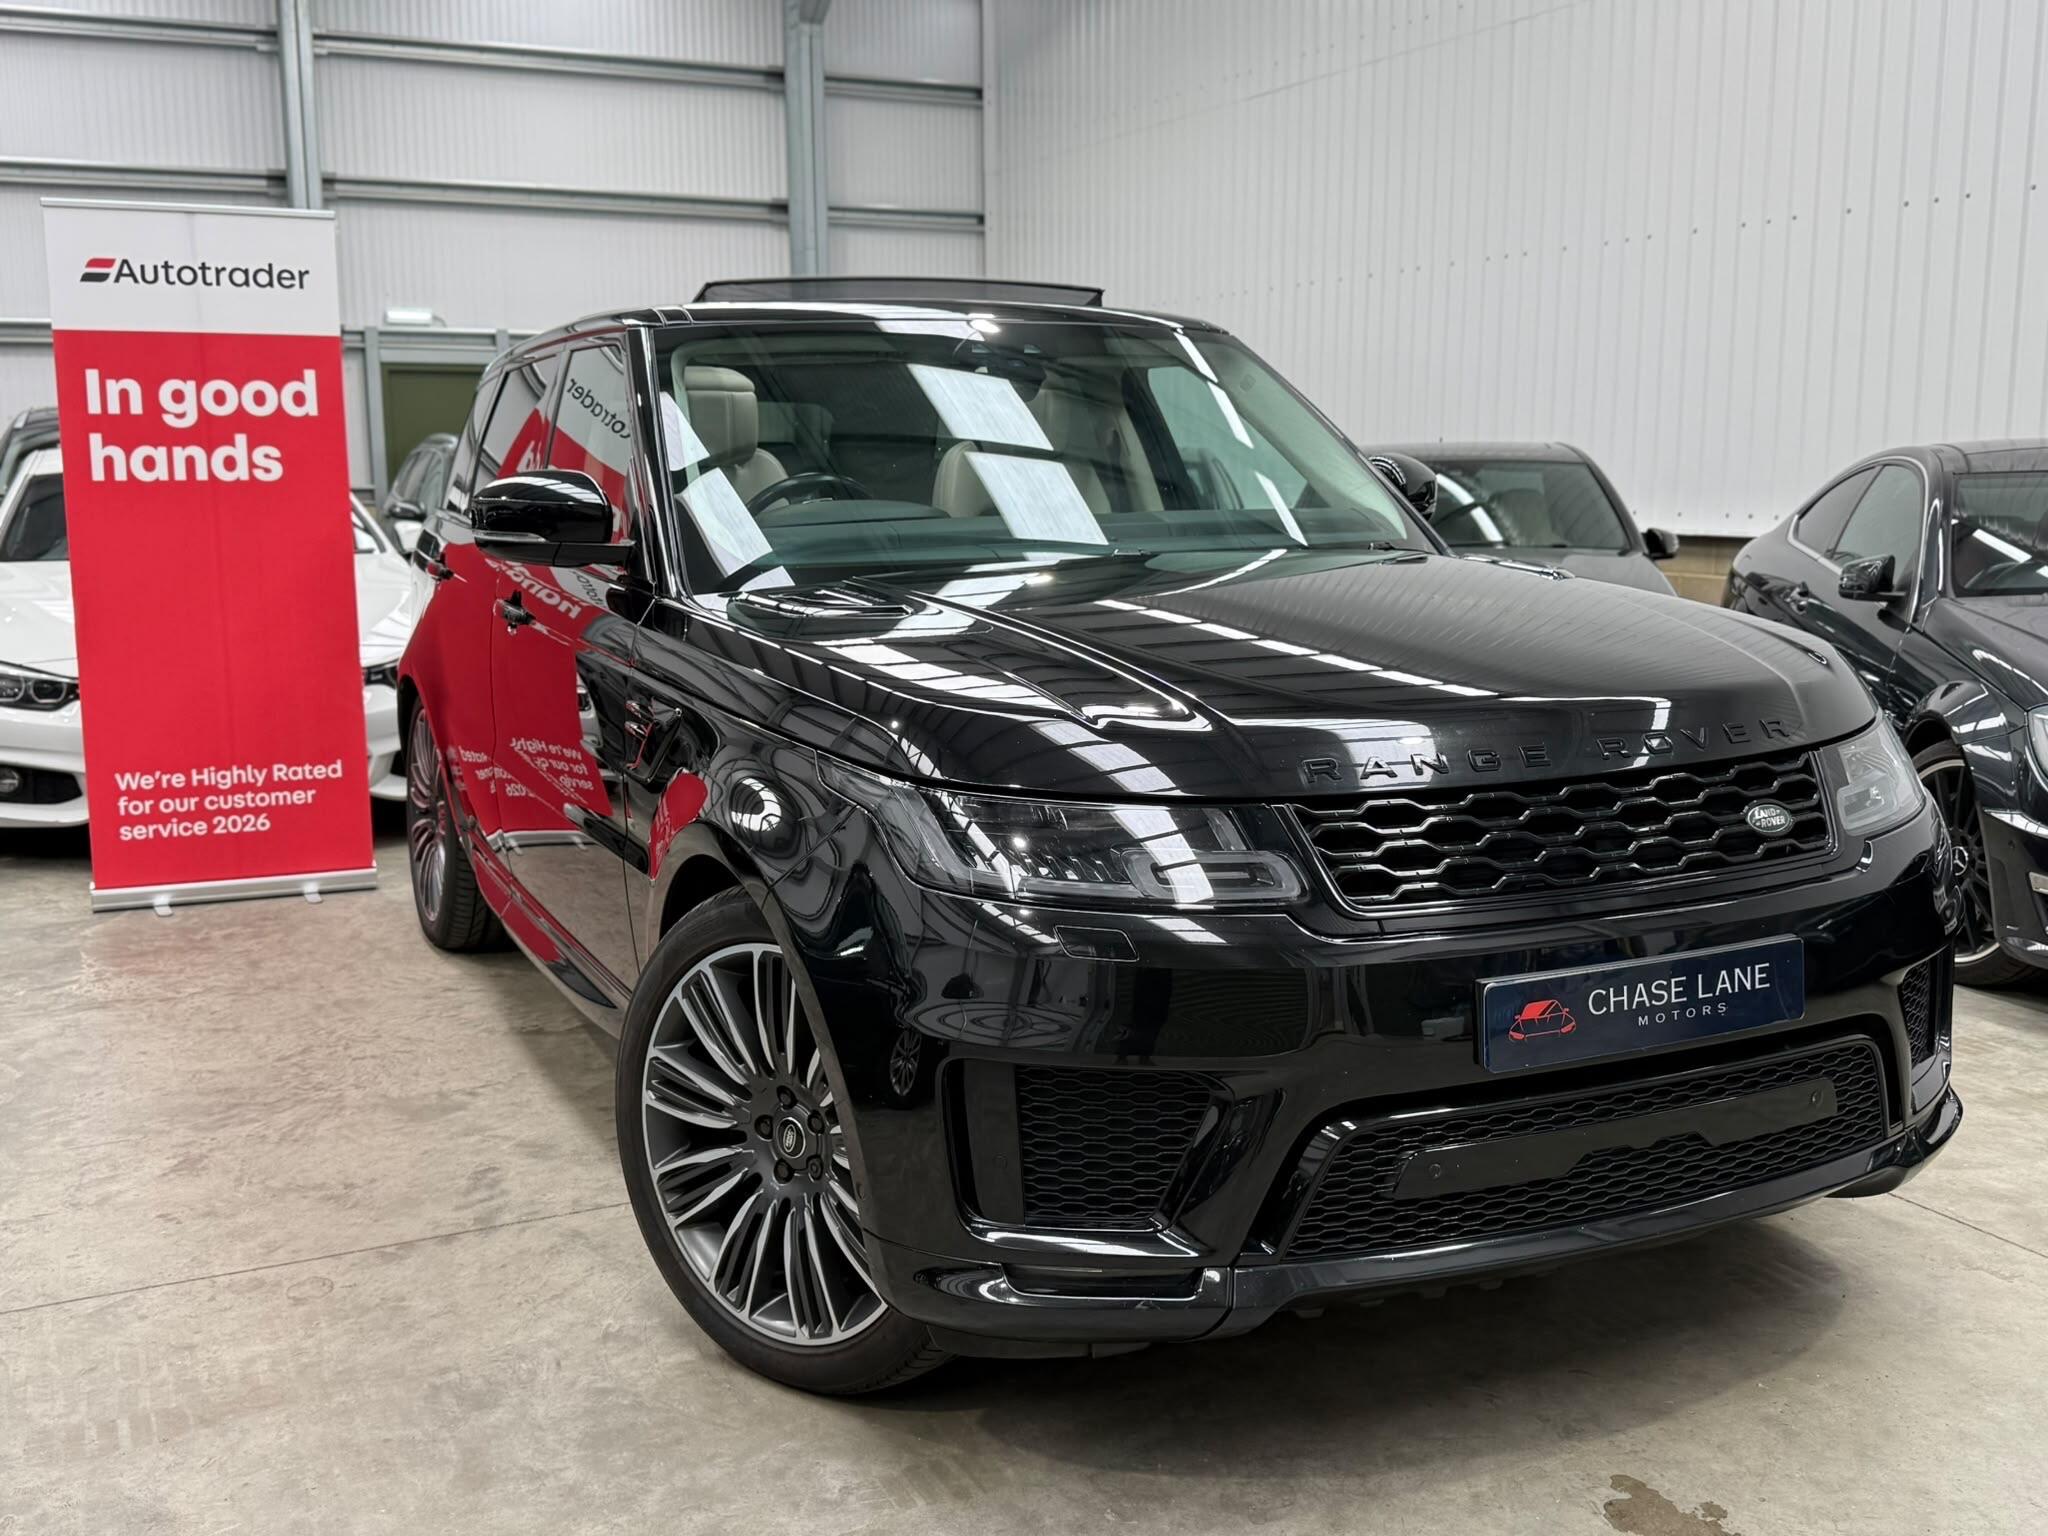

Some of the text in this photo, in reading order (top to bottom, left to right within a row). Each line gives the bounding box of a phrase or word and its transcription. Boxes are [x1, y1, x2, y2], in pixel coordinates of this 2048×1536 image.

[113, 259, 310, 289] Autotrader
[85, 368, 319, 429] In good
[88, 433, 284, 482] hands
[1301, 717, 1790, 784] RANGE ROVER
[114, 760, 342, 791] We're Highly Rated
[117, 788, 316, 815] for our customer
[119, 813, 271, 841] service 2026
[1761, 815, 1786, 828] ROVER
[1588, 962, 1771, 1016] CHASE LANE
[1638, 1002, 1728, 1027] MOTORS
